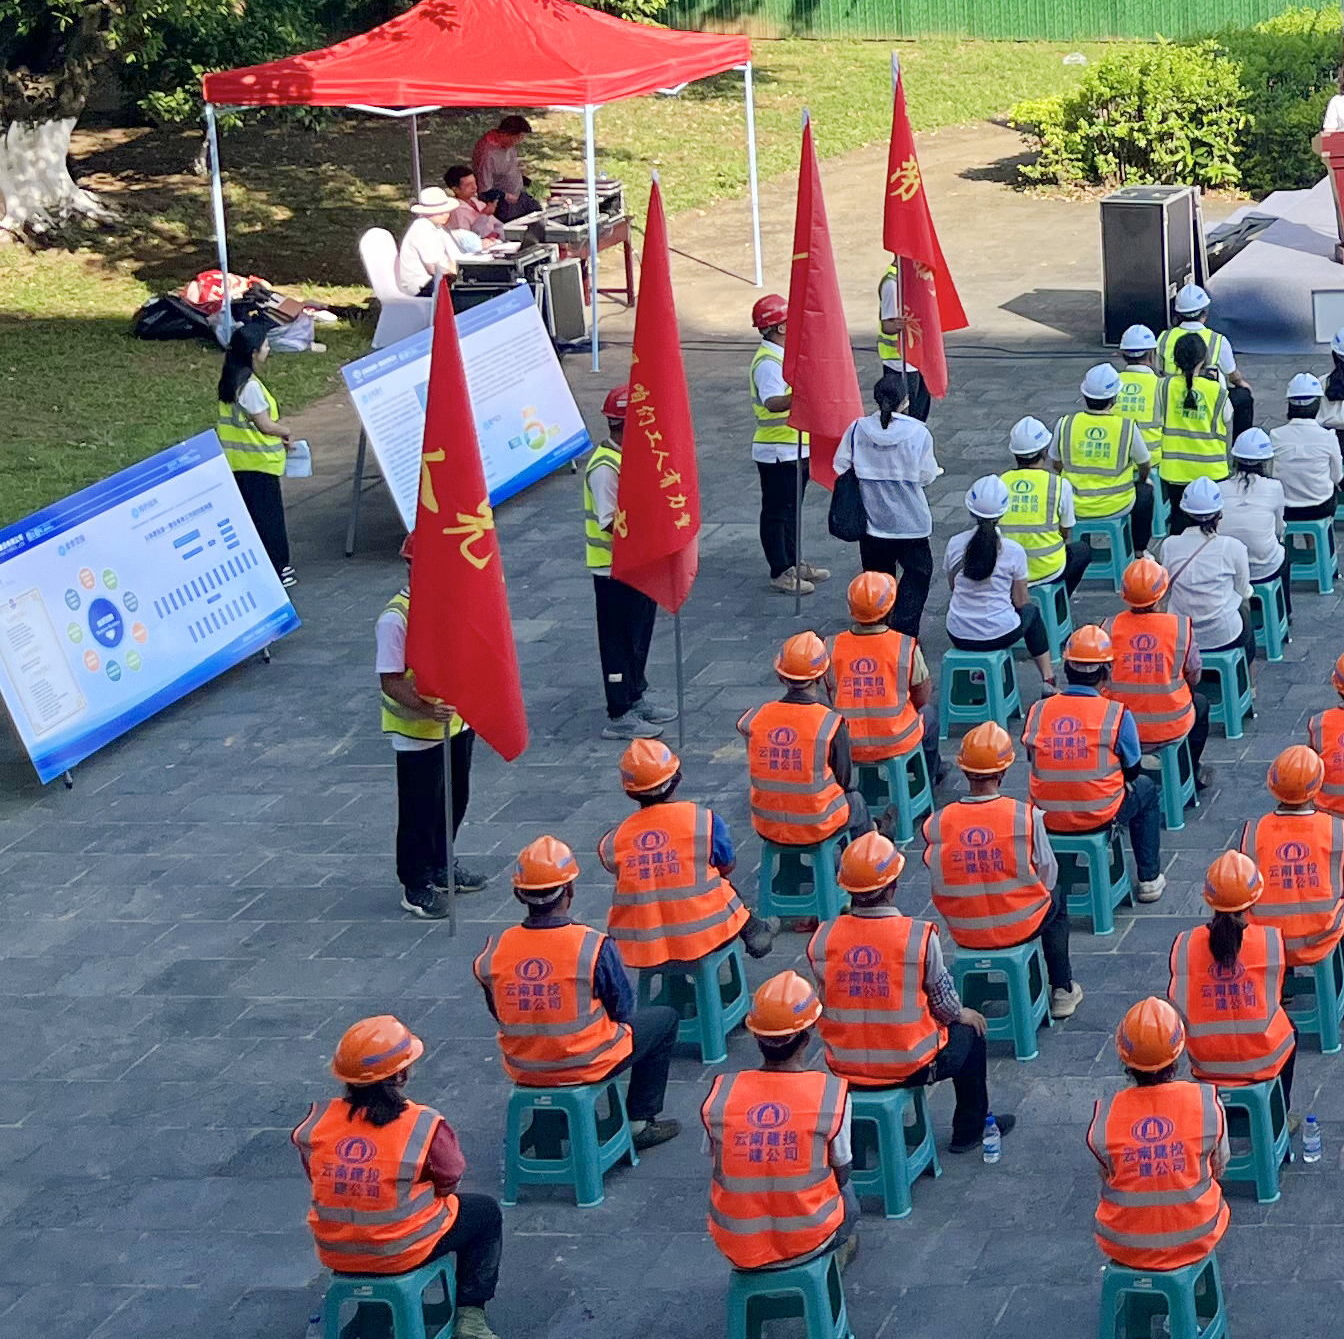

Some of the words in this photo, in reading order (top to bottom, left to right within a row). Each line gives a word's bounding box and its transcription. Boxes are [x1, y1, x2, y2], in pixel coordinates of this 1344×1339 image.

[627, 849, 679, 863] 云南建投
[1269, 863, 1318, 877] 云南建投
[837, 970, 889, 983] 云南建投
[504, 983, 560, 997] 云南建投
[1202, 981, 1254, 996] 云南建投
[735, 1131, 798, 1146] 云南建投
[735, 1147, 798, 1163] 一建公司
[1123, 1141, 1184, 1161] 云南建投
[322, 1163, 380, 1182] 云南建投
